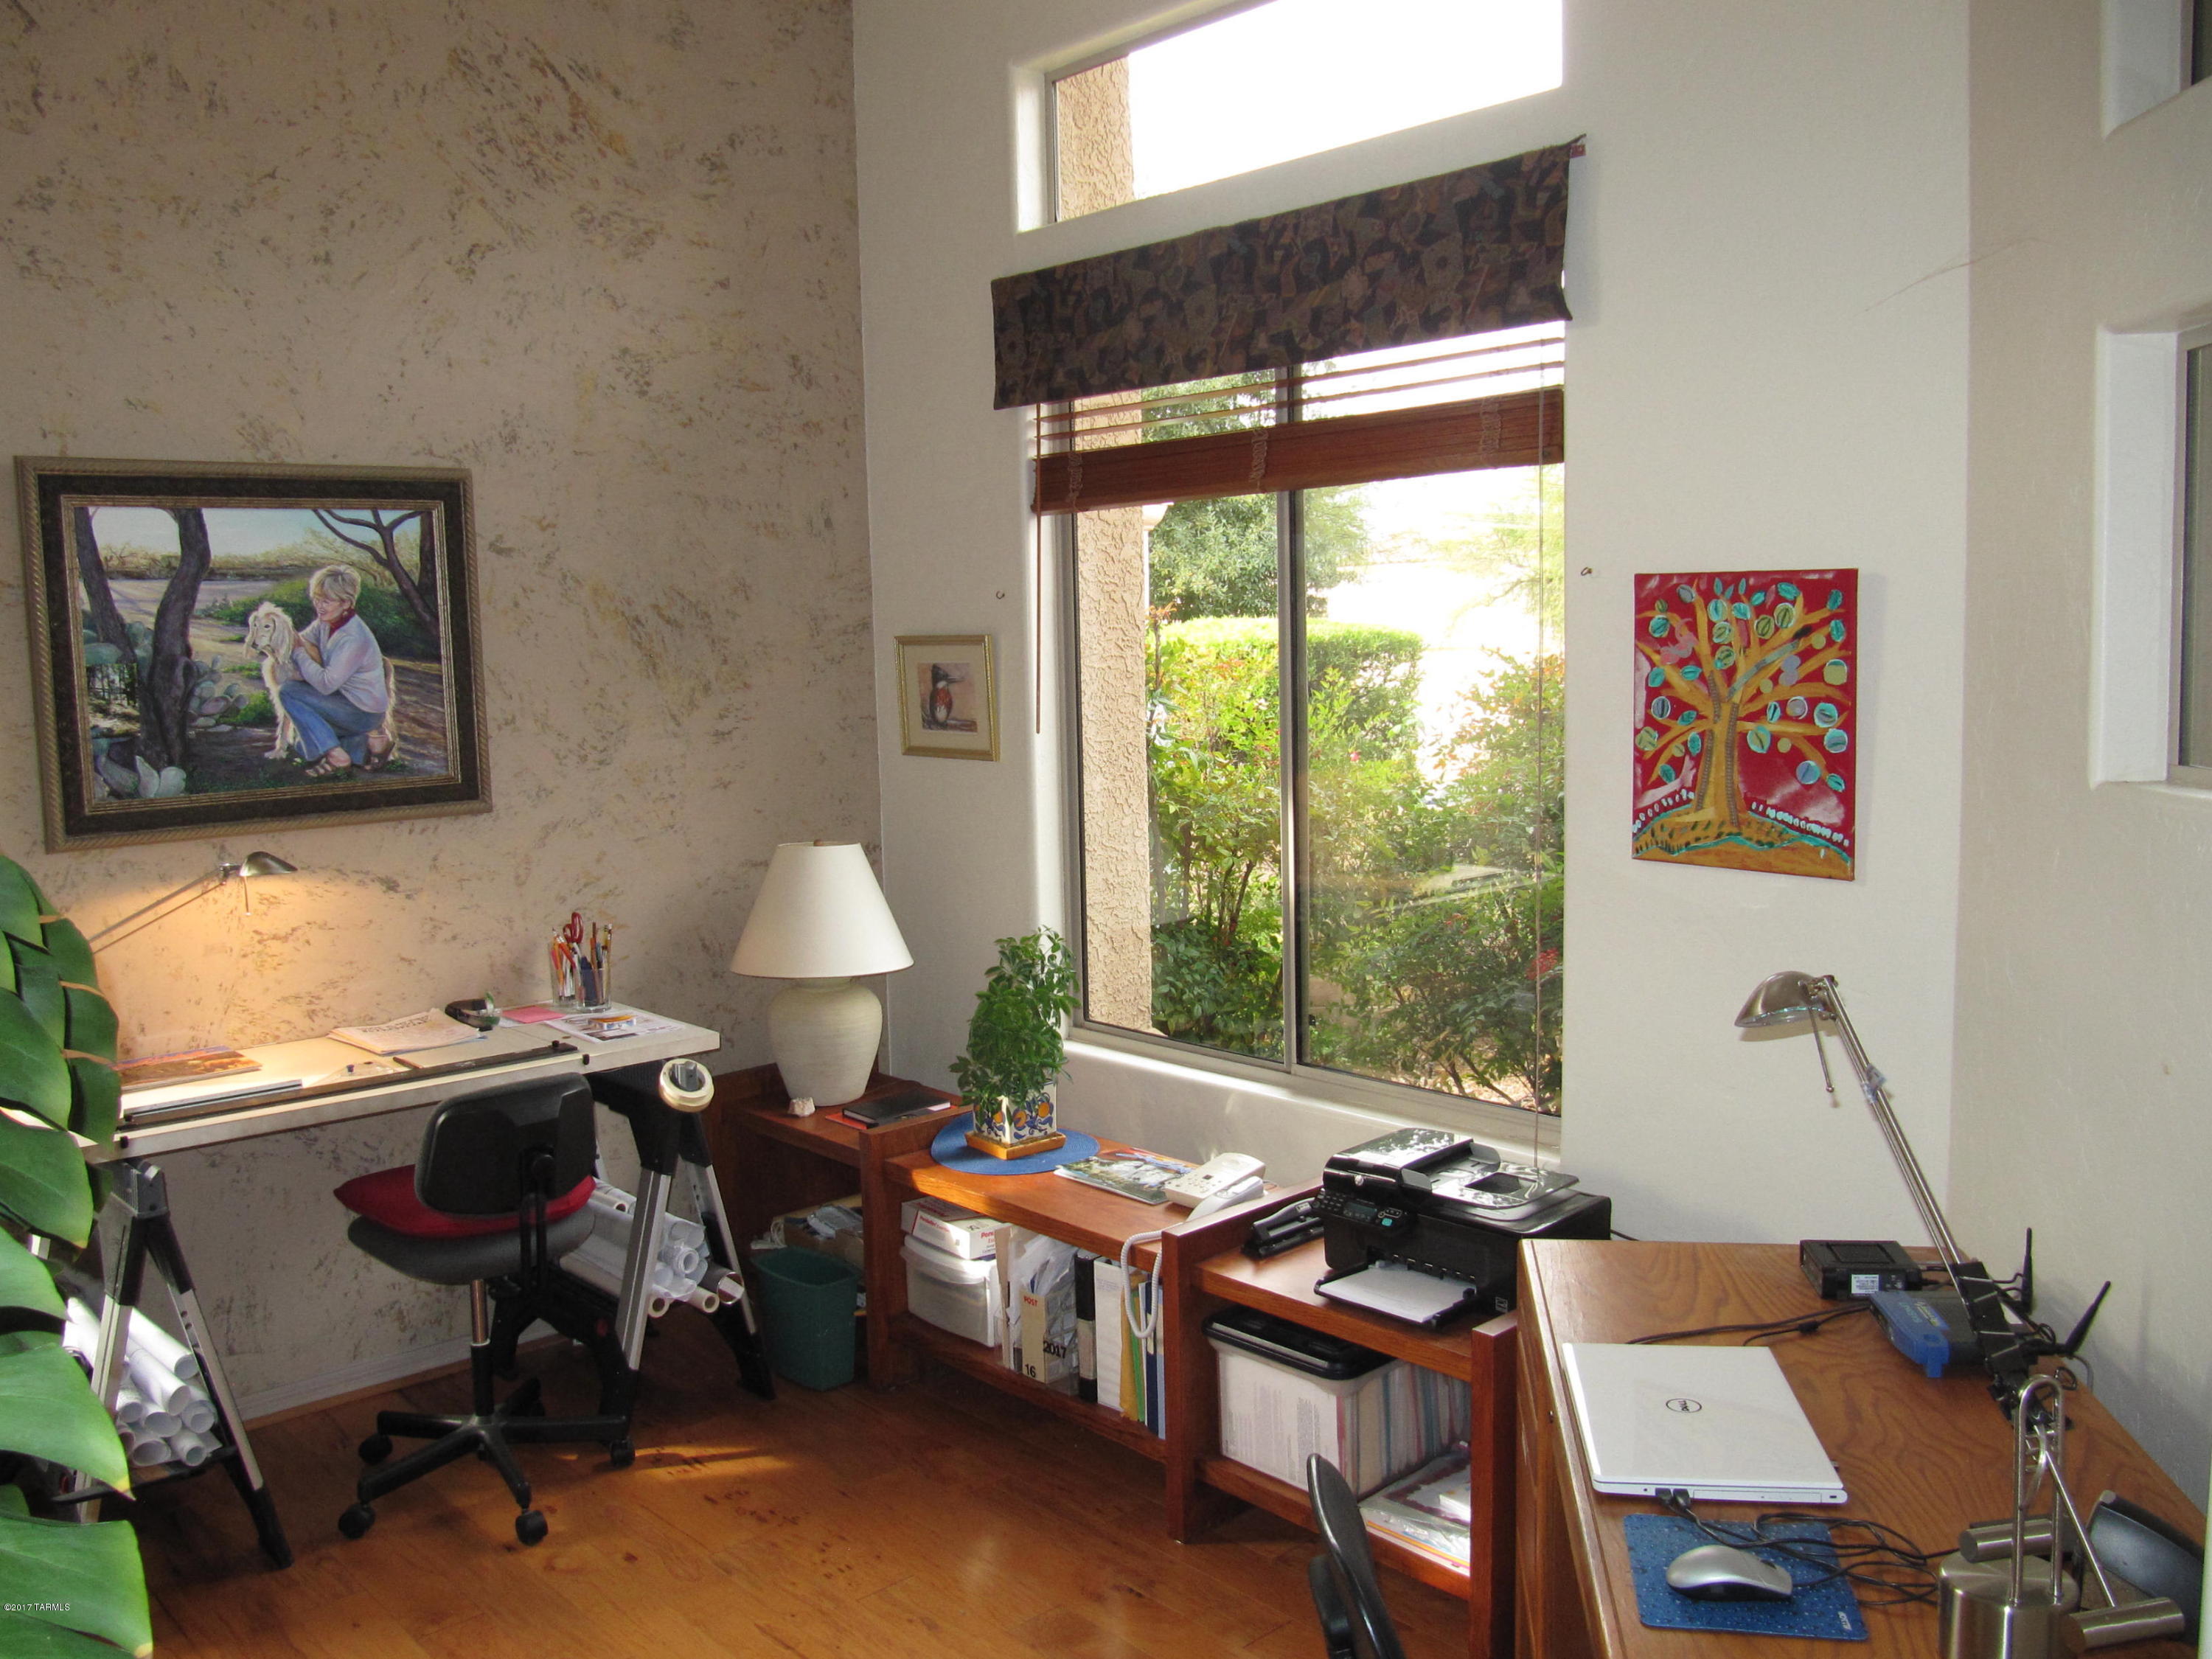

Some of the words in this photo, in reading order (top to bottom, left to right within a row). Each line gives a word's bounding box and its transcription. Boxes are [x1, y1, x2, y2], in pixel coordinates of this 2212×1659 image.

[1023, 1295, 1038, 1307] POST
[1043, 1340, 1067, 1359] 2017
[1025, 1363, 1037, 1378] 16
